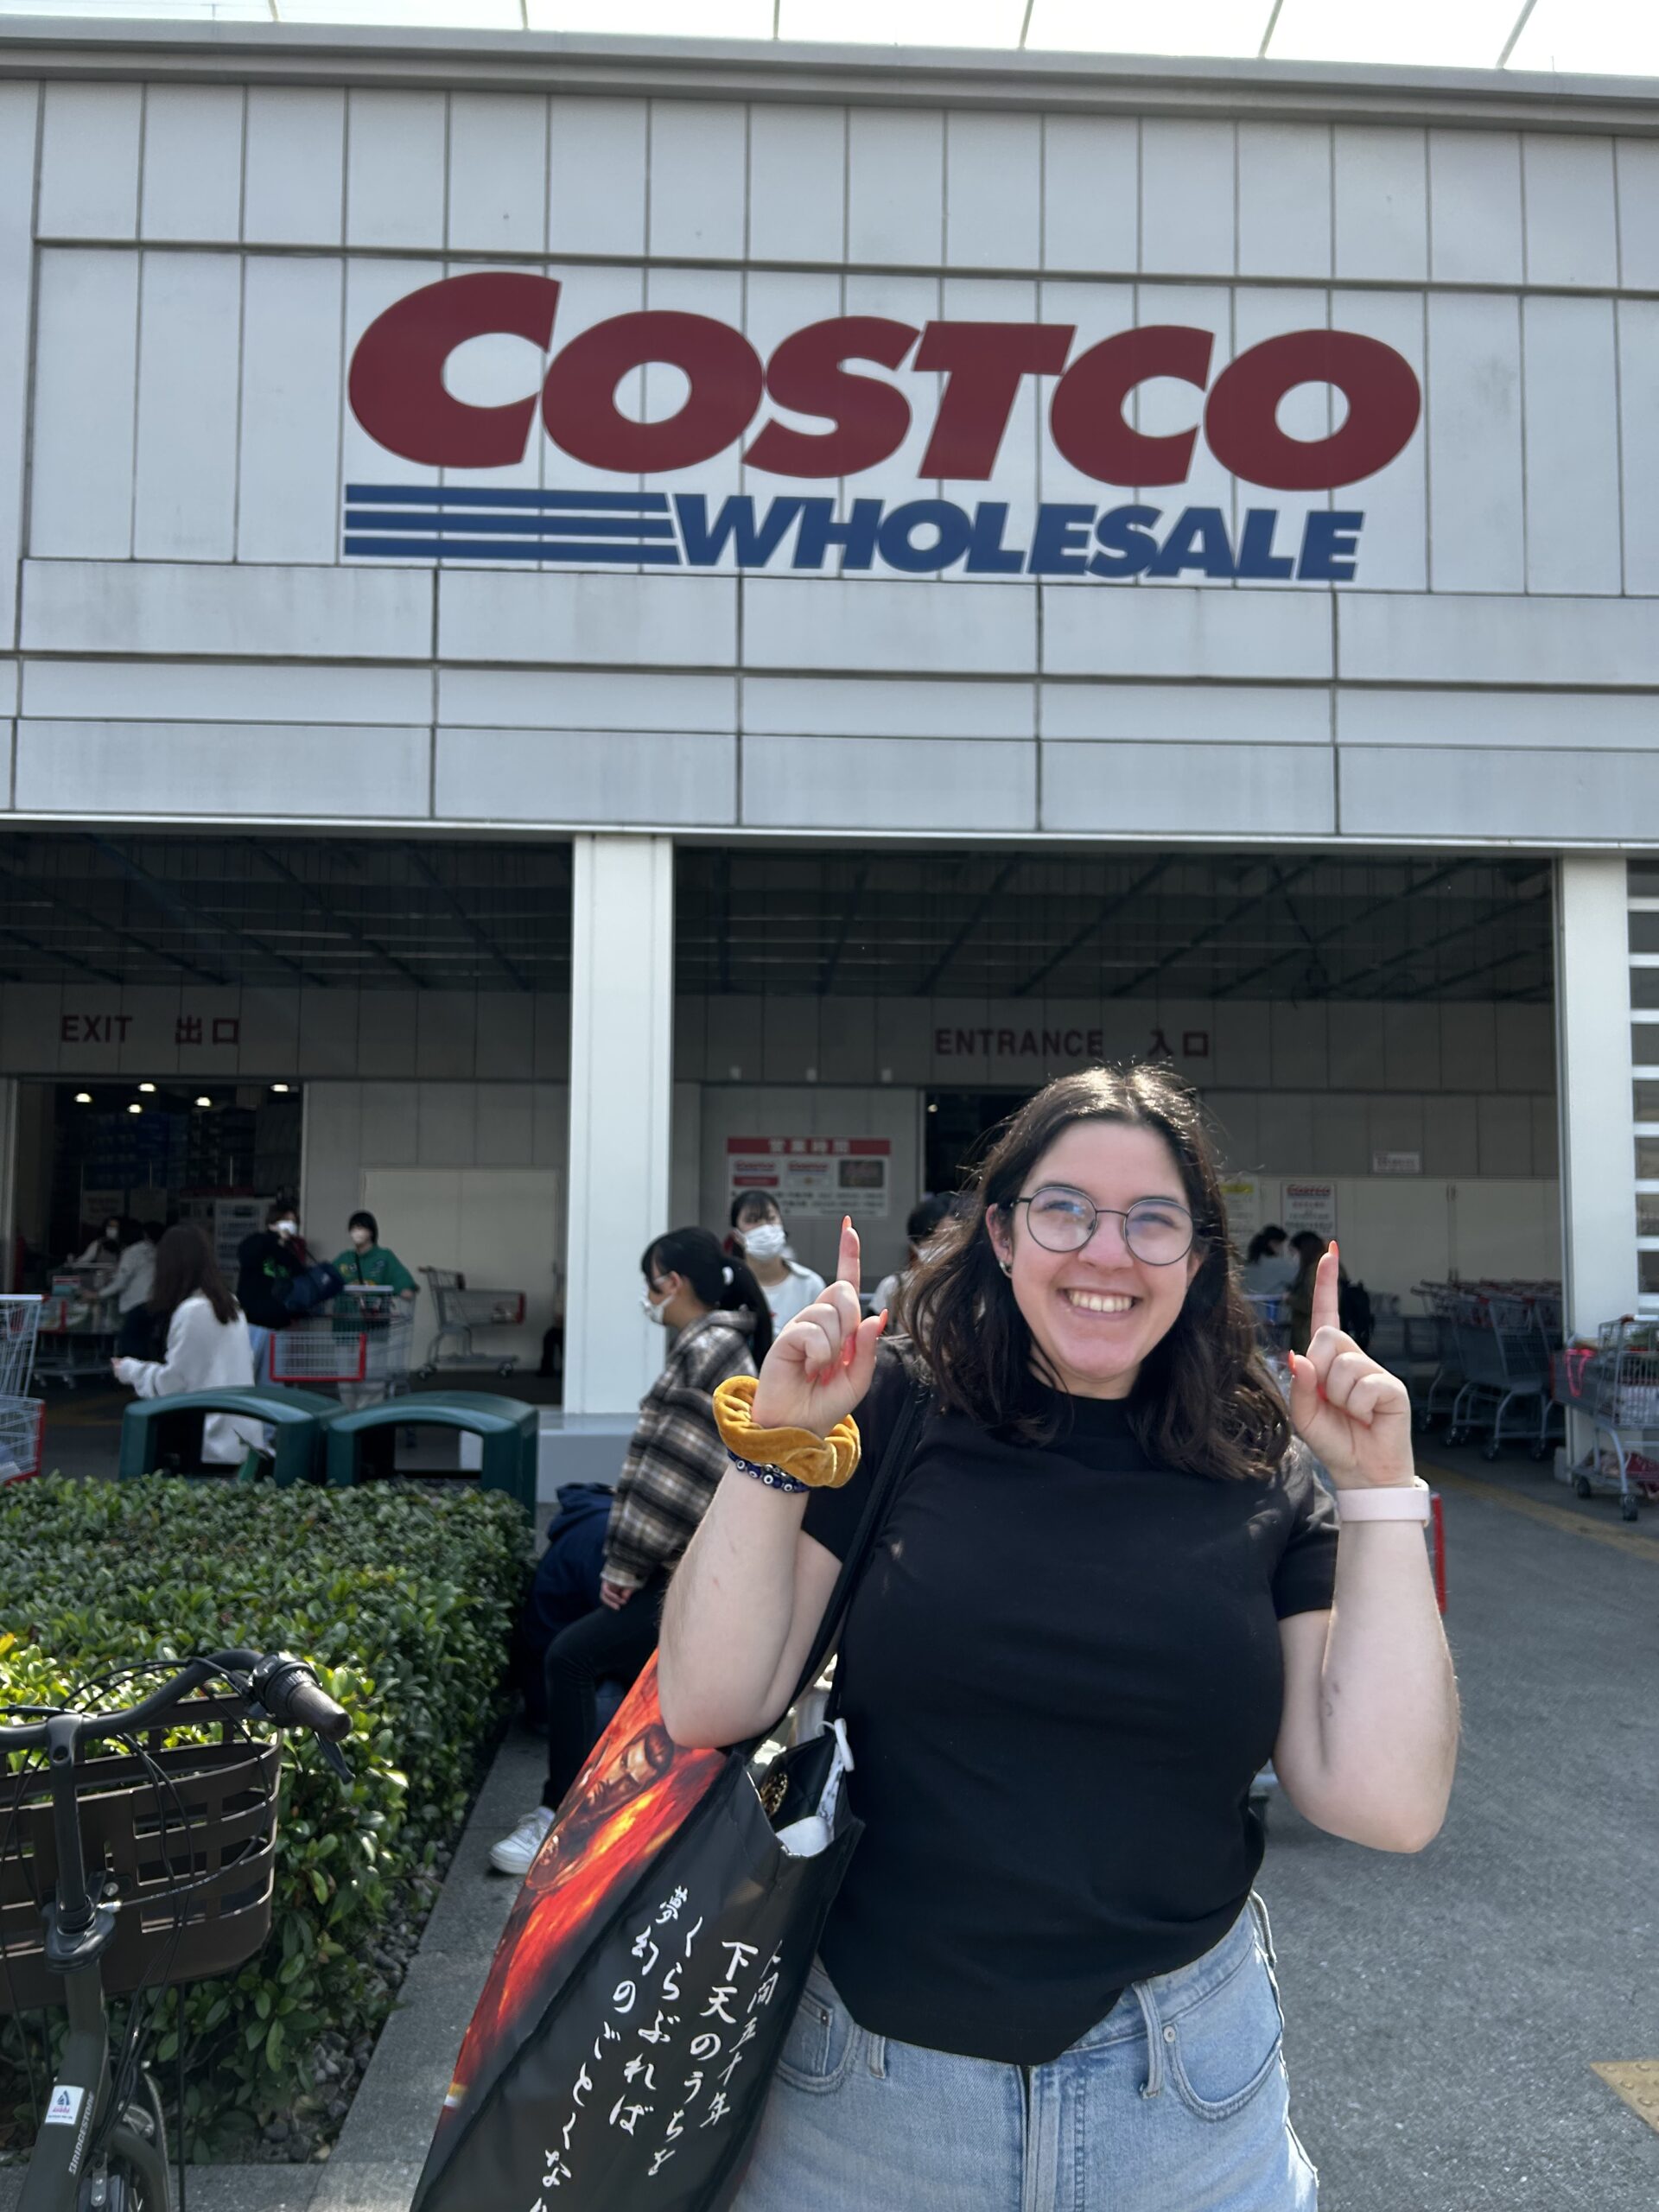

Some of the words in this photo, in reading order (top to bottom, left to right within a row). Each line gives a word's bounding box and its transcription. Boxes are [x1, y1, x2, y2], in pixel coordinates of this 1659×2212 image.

[347, 271, 1421, 492] COSTCO
[672, 493, 1366, 582] WHOLESALE
[60, 1014, 133, 1043] EXIT
[175, 1015, 240, 1045] 出口
[934, 1028, 1103, 1057] ENTRANCE
[1147, 1027, 1210, 1058] 入口
[608, 1916, 703, 2137] くらぶれば
[647, 1941, 759, 2177] 下天のうちを
